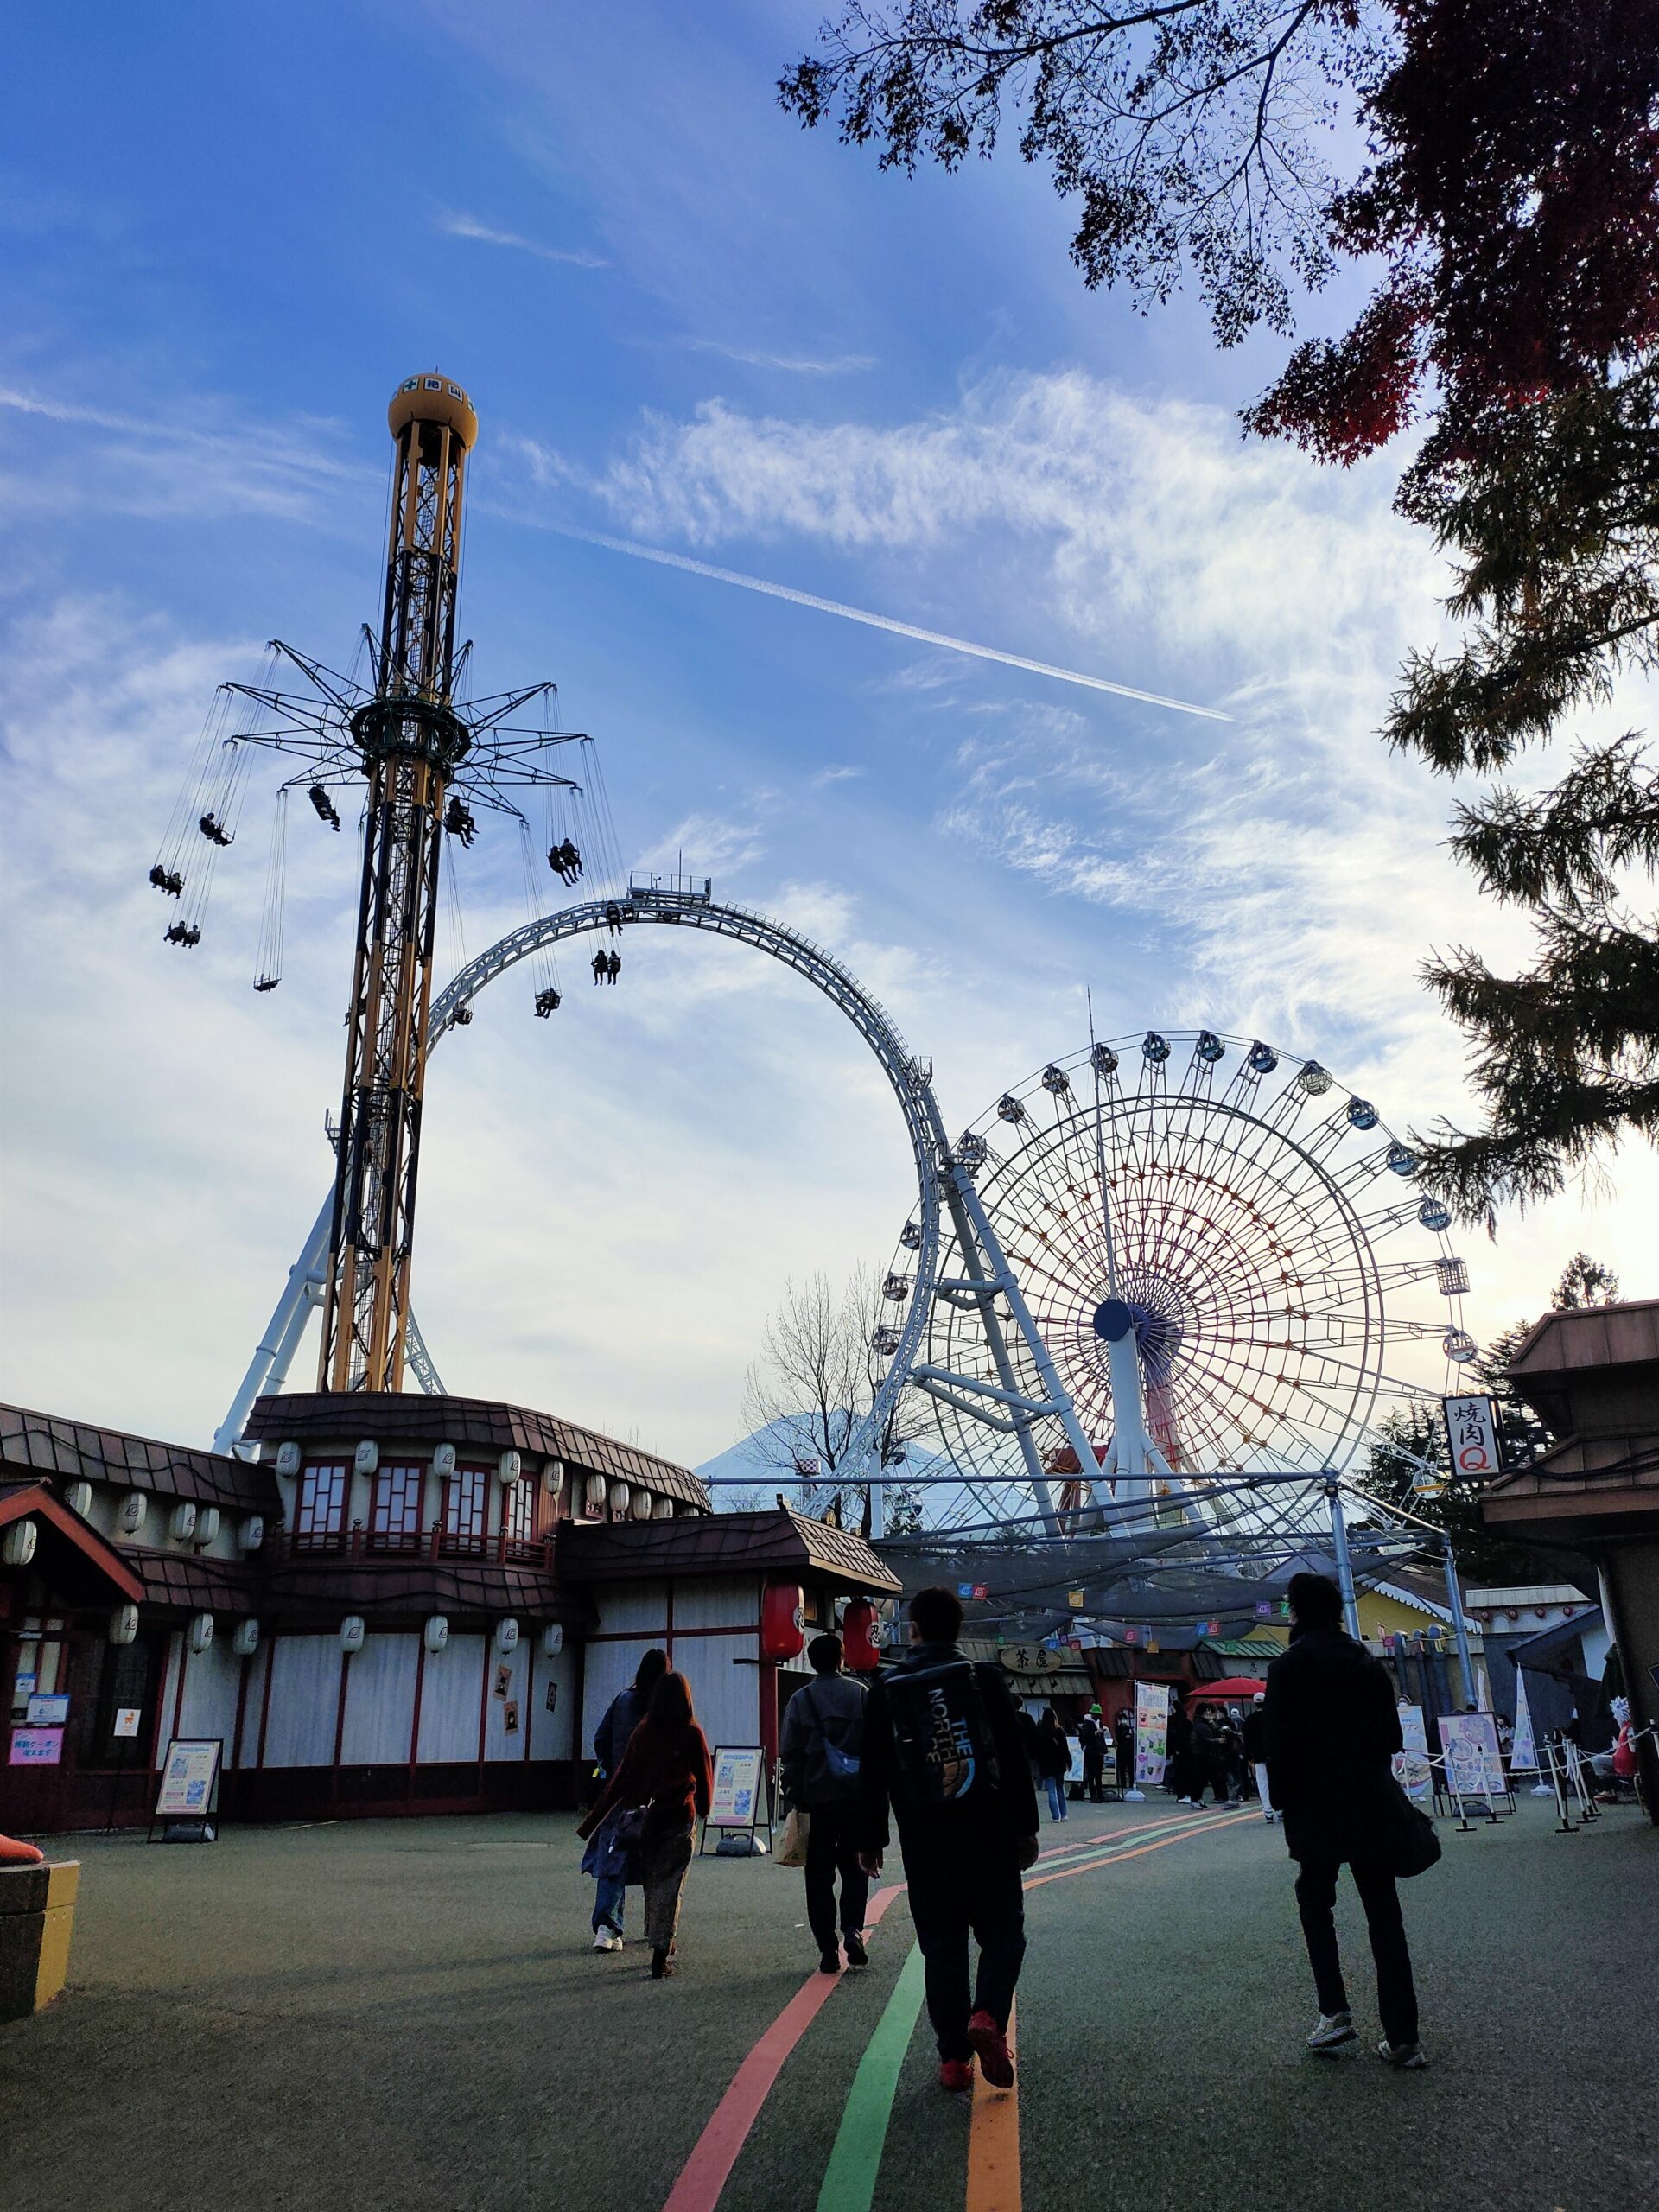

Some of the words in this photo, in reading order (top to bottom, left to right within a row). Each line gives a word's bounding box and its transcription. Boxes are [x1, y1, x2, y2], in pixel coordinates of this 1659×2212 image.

[1015, 1648, 1048, 1669] 茶屋
[927, 1688, 957, 1762] NORTH
[951, 1715, 974, 1757] THE
